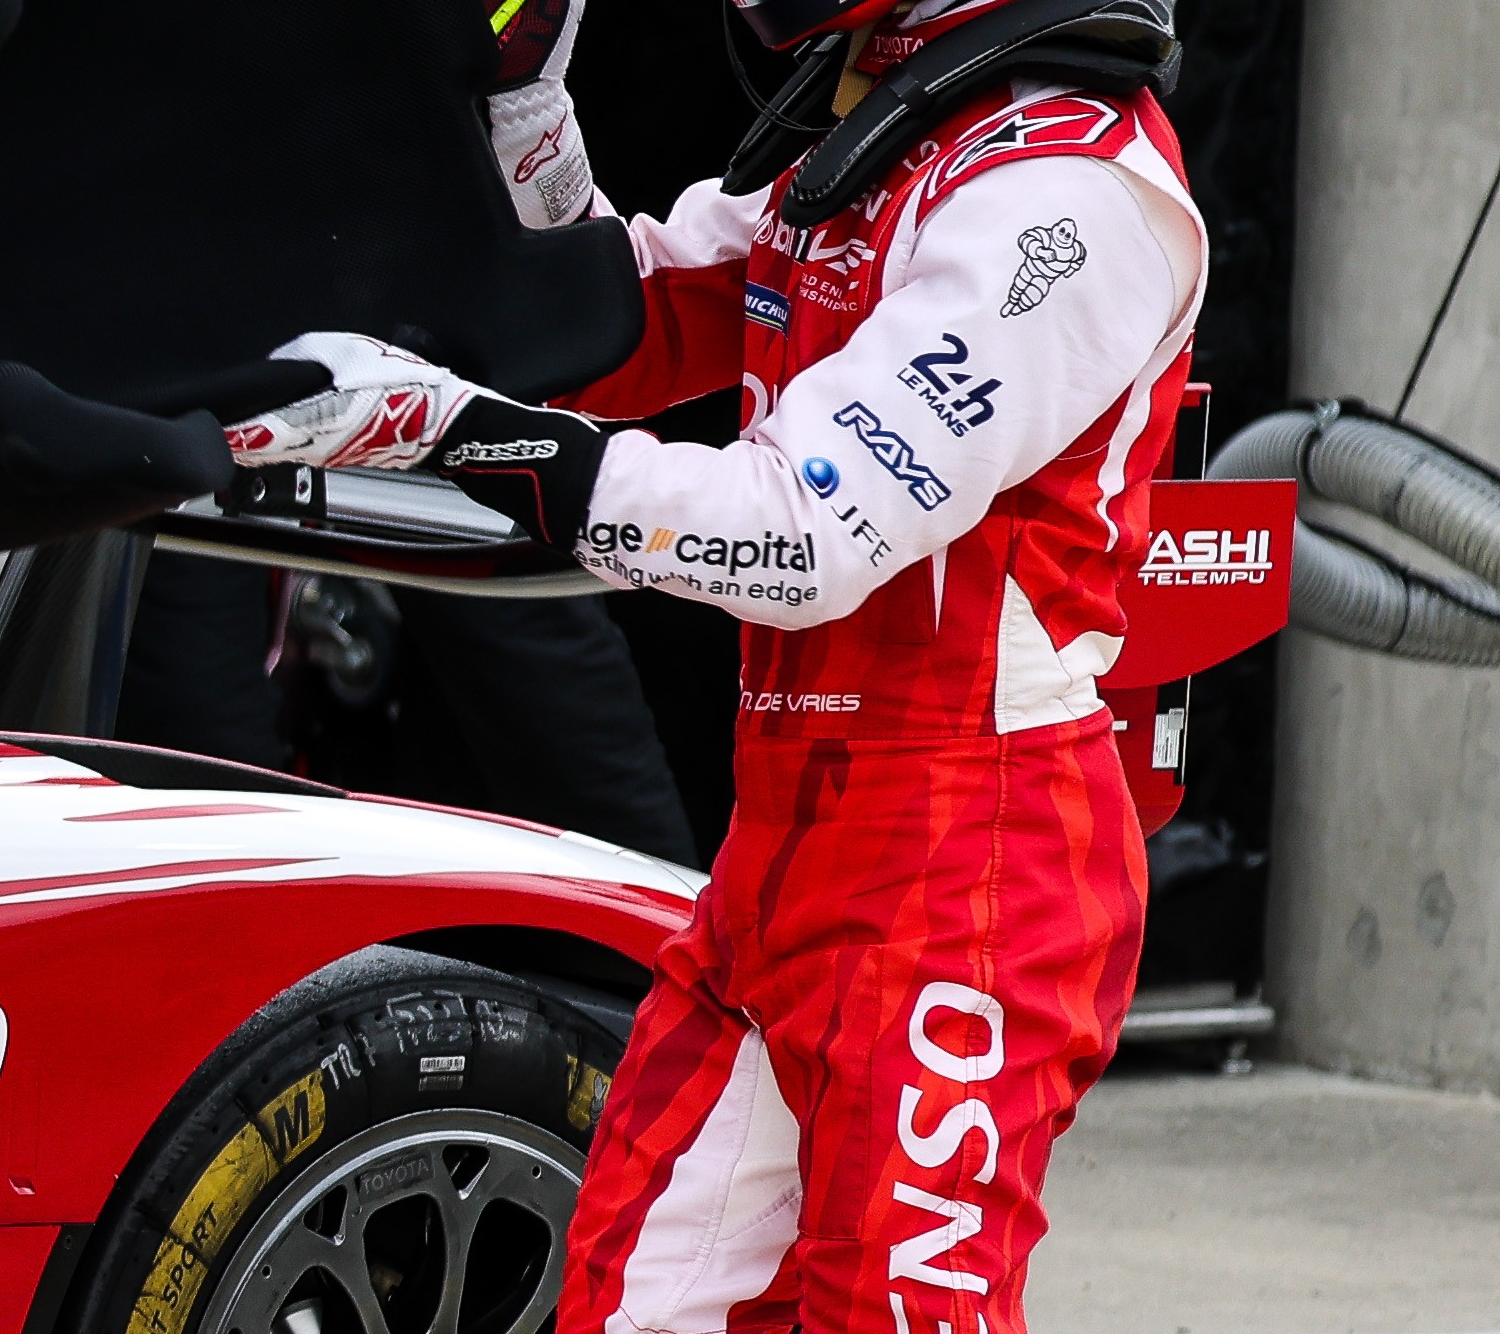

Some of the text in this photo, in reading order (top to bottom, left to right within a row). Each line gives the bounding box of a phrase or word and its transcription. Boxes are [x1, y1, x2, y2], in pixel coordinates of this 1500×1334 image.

[896, 367, 969, 439] LE MANS
[908, 333, 999, 426] 24h
[832, 400, 952, 511] RAYS
[674, 529, 816, 579] capital
[831, 505, 893, 568] JFE
[1146, 529, 1272, 564] ASHI
[708, 580, 819, 607] an edge
[1136, 569, 1267, 586] TELEMPU
[754, 693, 862, 714] DE VRIES
[362, 1159, 430, 1196] TOYOTA
[161, 1203, 221, 1304] SPORT
